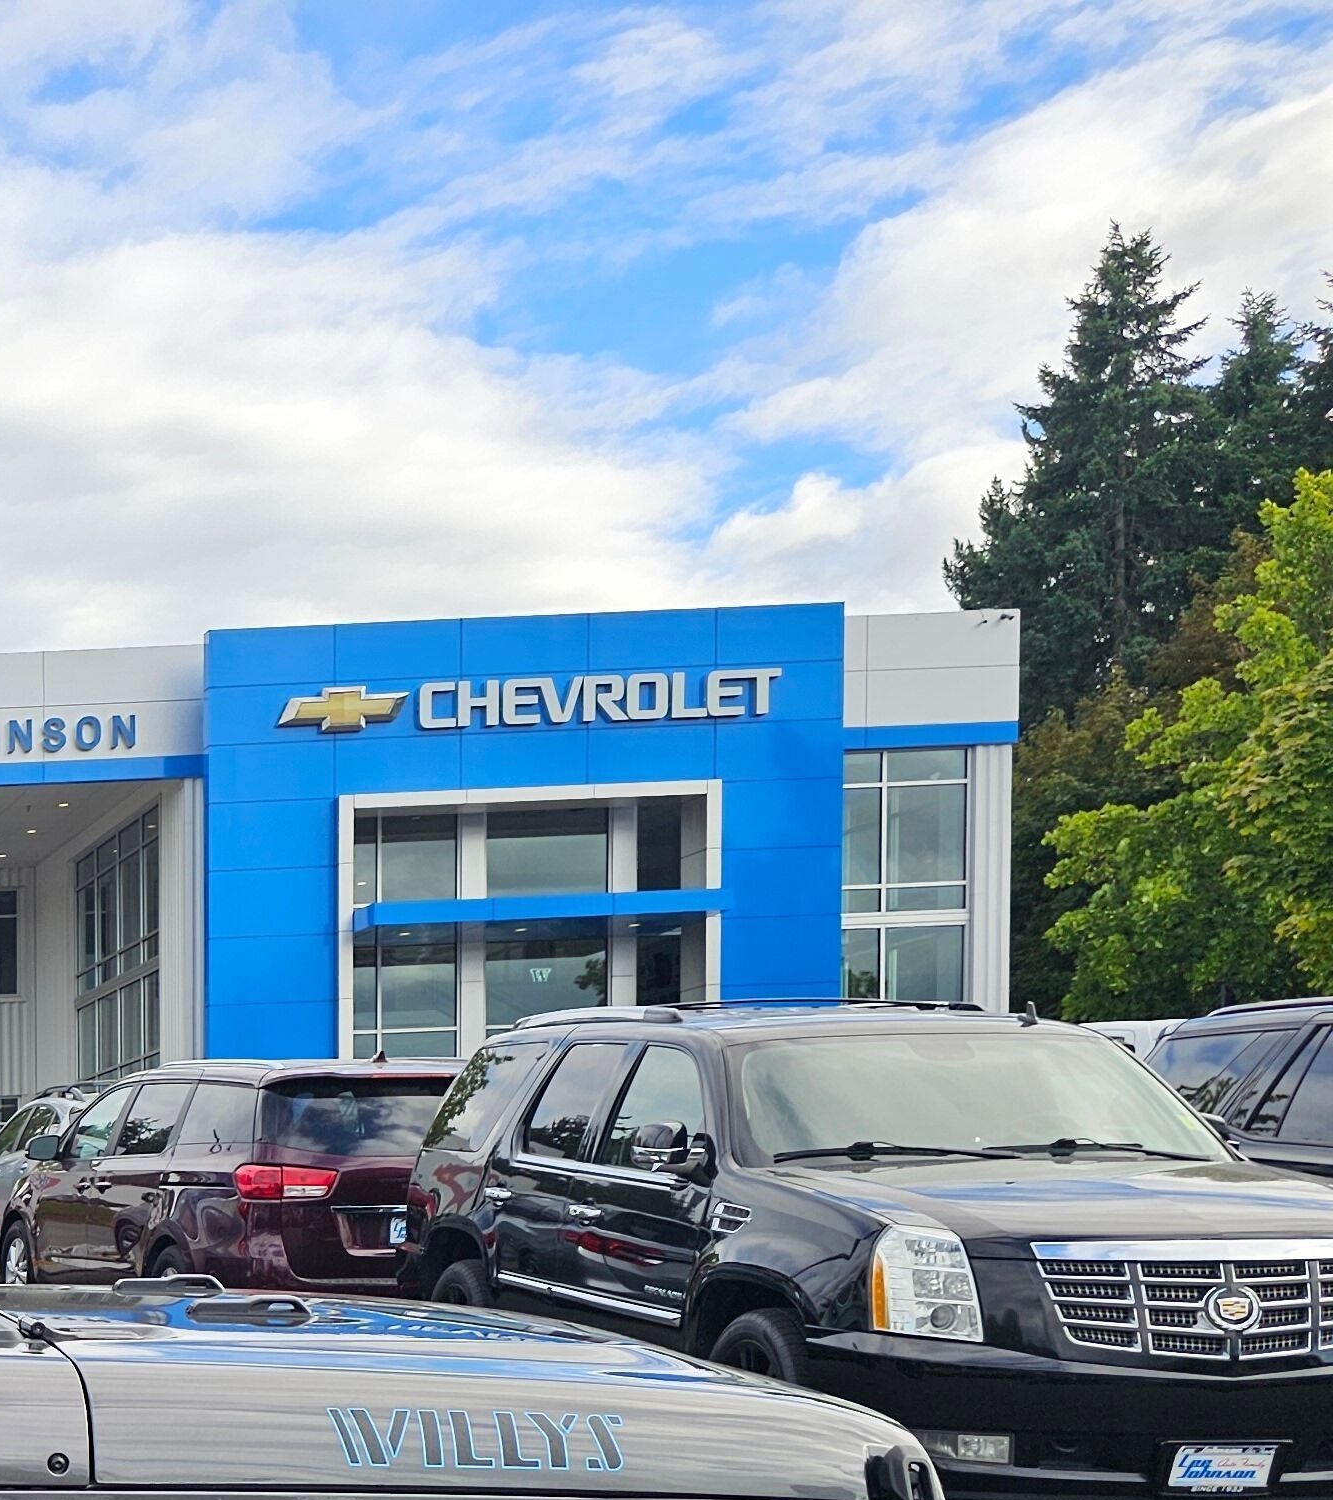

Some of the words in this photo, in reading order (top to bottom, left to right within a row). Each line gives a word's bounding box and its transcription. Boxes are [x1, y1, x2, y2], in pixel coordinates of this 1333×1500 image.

[419, 667, 782, 730] CHEVROLET
[326, 1406, 624, 1472] WILLYS
[1176, 1462, 1257, 1479] Johnson
[1178, 1453, 1213, 1468] Lee
